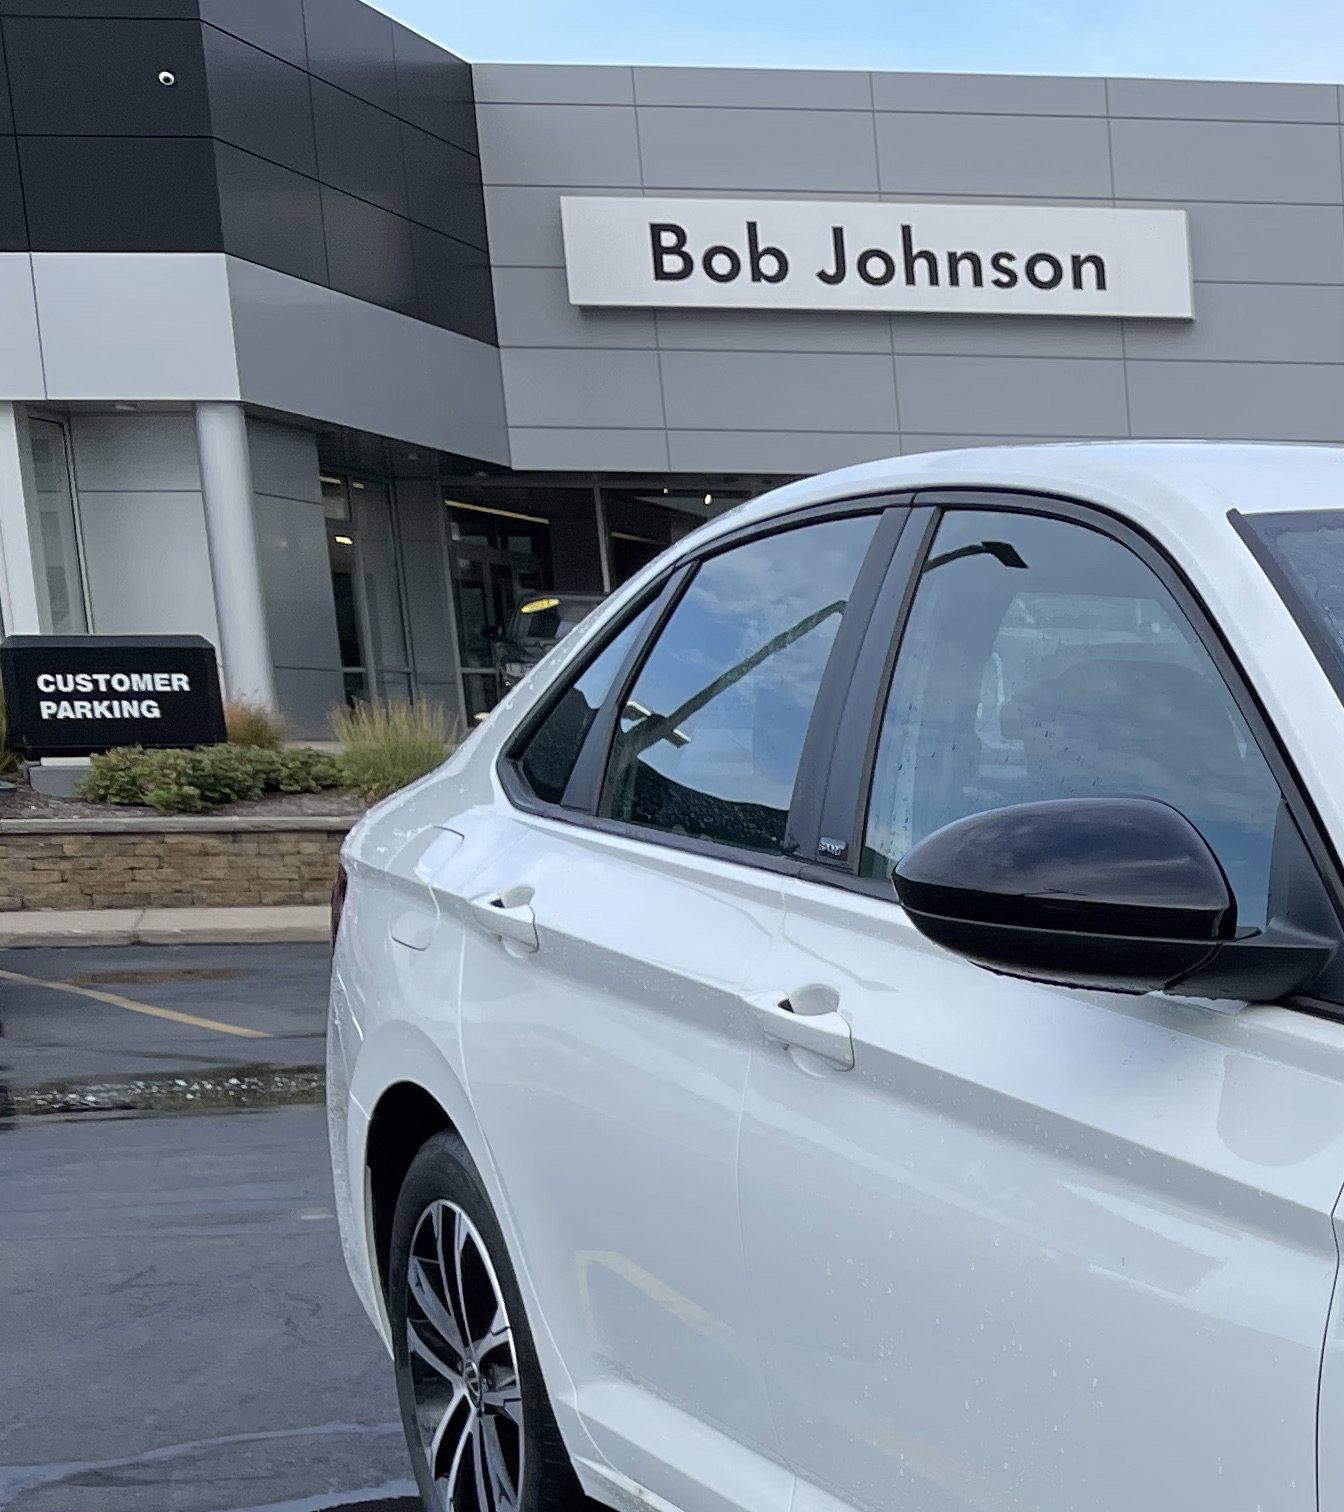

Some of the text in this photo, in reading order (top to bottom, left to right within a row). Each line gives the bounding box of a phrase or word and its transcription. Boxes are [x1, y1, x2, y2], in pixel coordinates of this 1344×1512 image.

[649, 221, 1107, 291] Bob Johnson
[36, 672, 191, 693] CUSTOMER
[40, 700, 162, 720] PARKING
